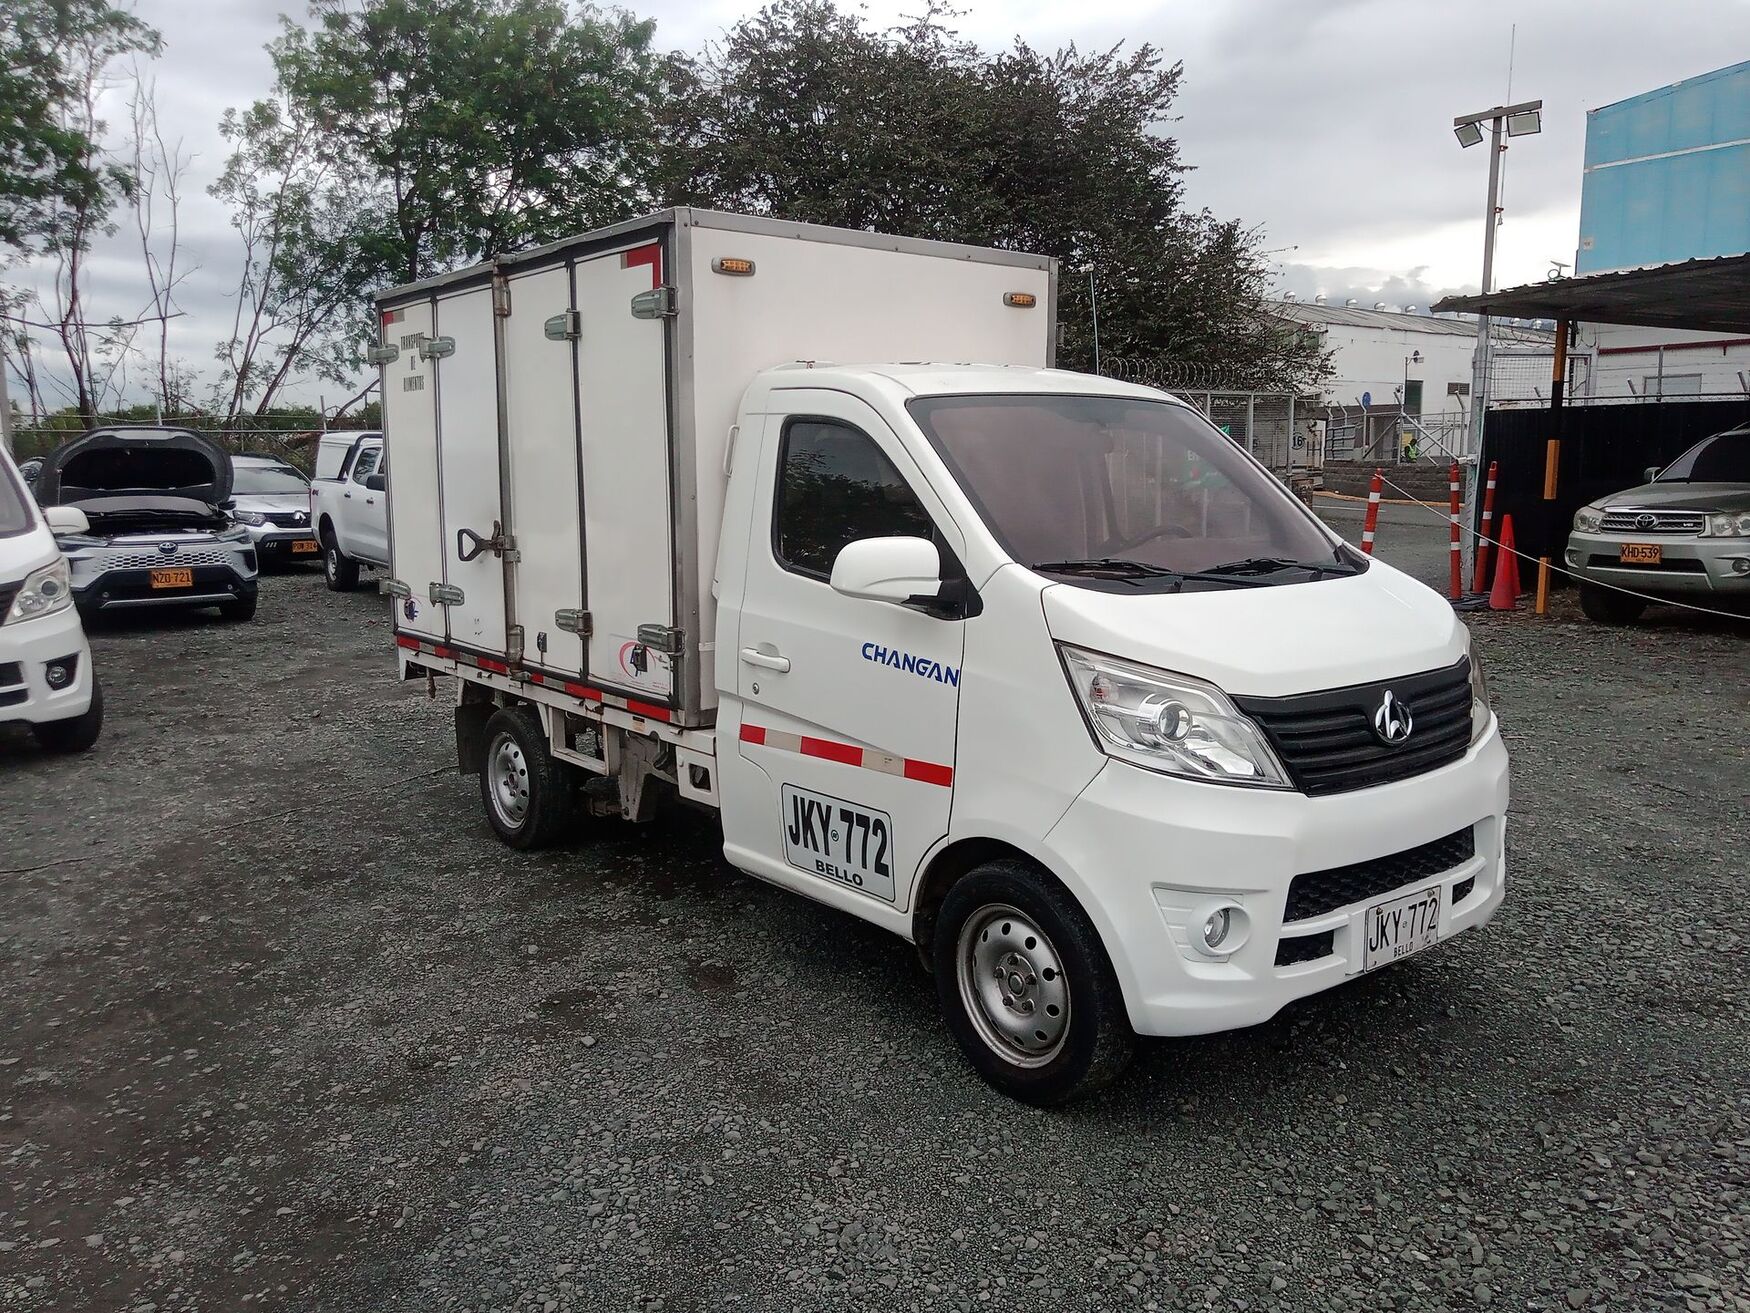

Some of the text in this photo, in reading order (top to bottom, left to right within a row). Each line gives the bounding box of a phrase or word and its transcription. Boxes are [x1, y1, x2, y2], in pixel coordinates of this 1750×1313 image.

[861, 642, 960, 688] CHANGAN
[815, 859, 863, 887] BELLO
[1393, 941, 1414, 958] BELLO
